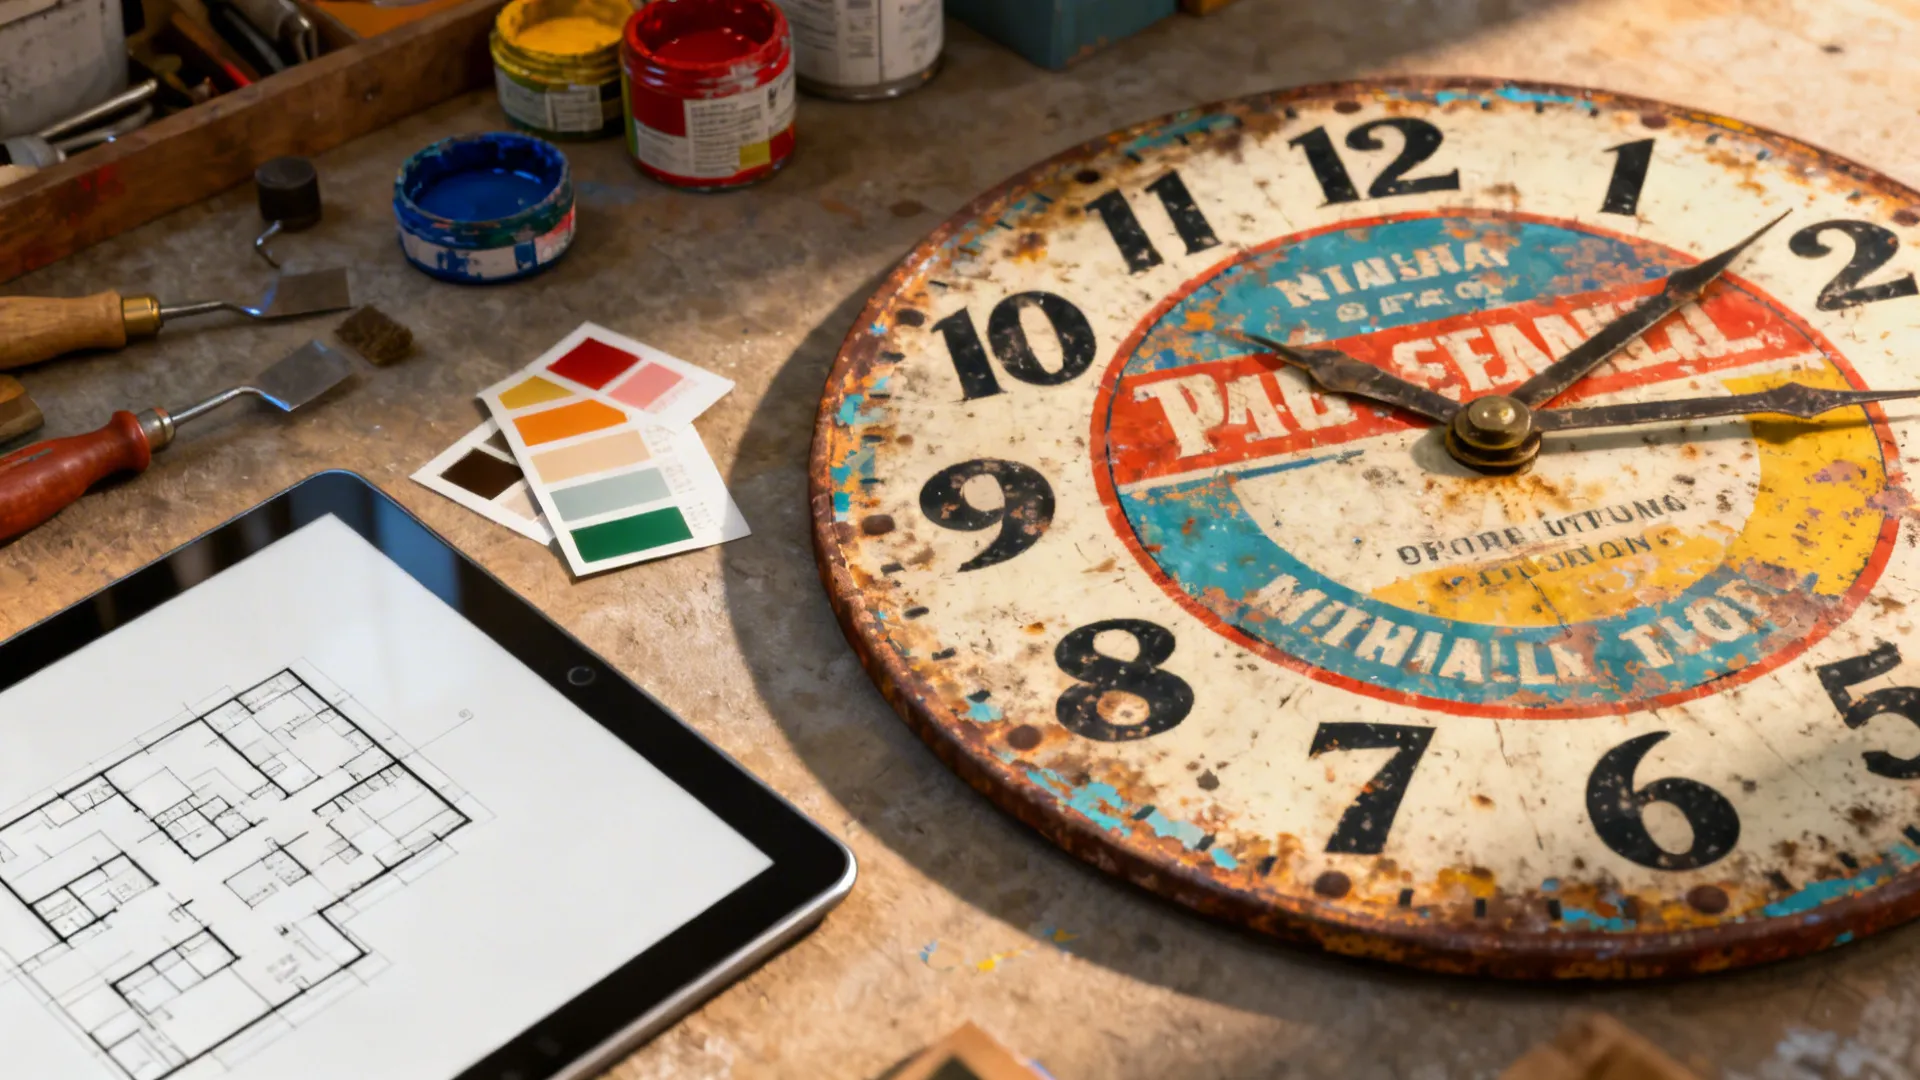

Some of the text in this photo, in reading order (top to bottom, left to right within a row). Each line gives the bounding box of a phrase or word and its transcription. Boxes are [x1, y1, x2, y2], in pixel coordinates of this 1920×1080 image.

[1288, 116, 1461, 207] 12
[1602, 138, 1657, 216] 1
[1084, 169, 1222, 274] 11
[1788, 219, 1919, 312] 2
[931, 290, 1096, 402] 10
[918, 459, 1057, 573] 9
[1055, 618, 1195, 742] 8
[1815, 637, 1920, 780] 5
[1308, 721, 1436, 856] 7
[1586, 730, 1742, 873] 6
